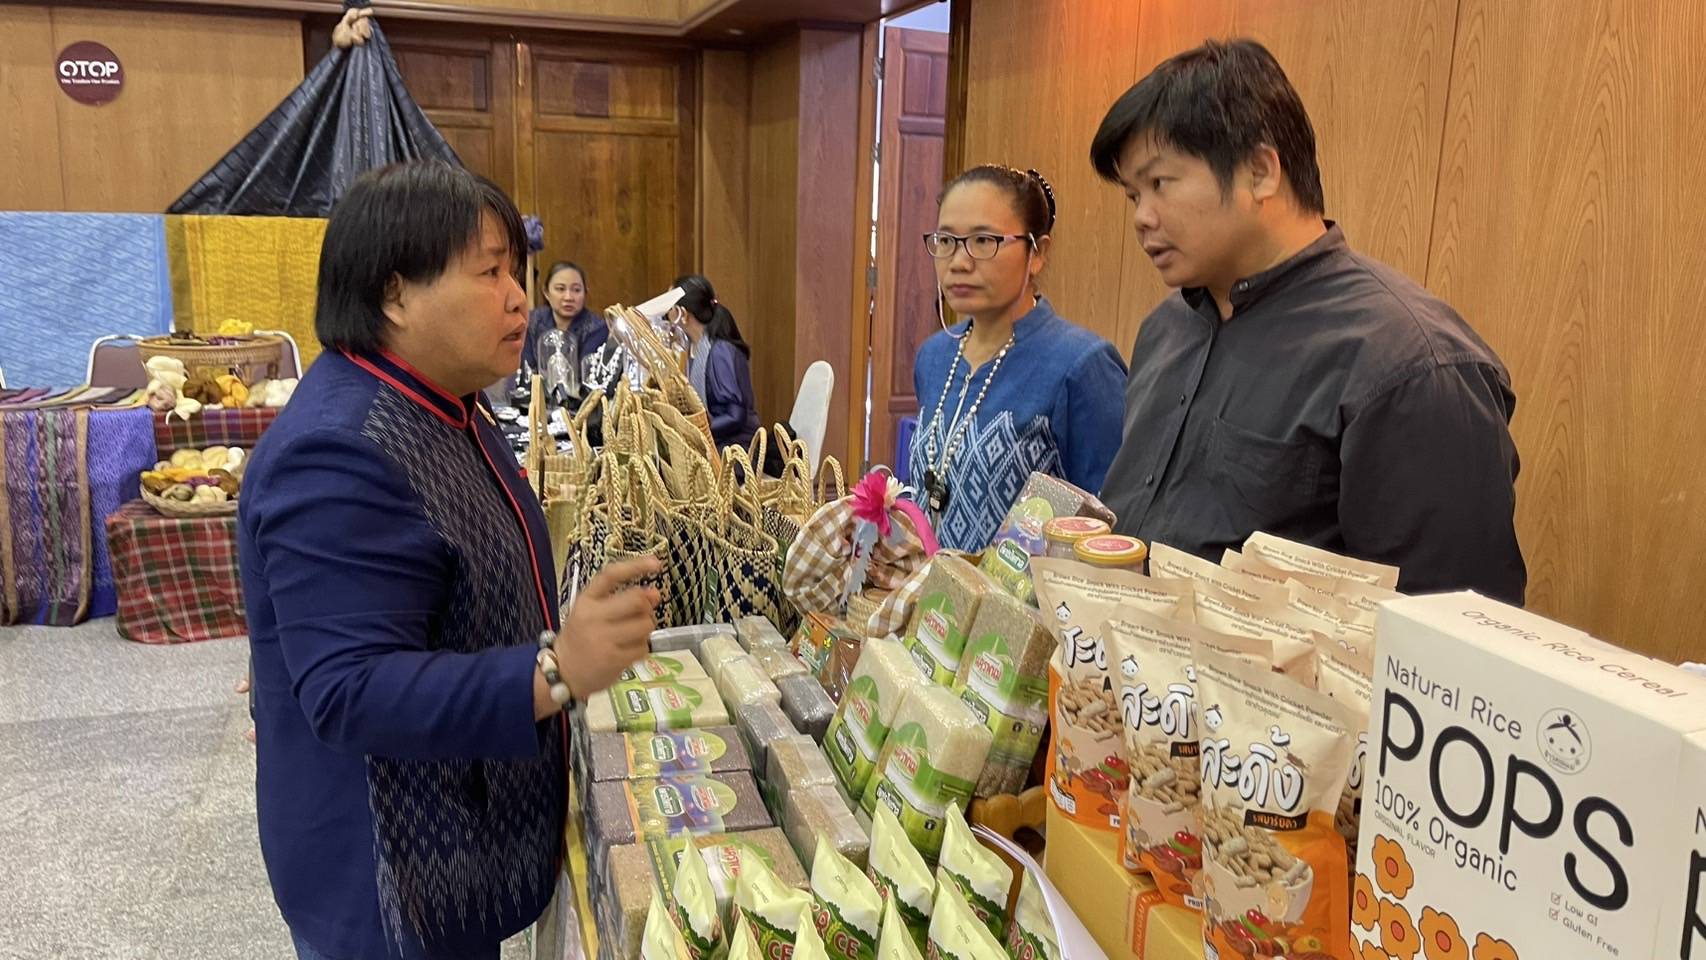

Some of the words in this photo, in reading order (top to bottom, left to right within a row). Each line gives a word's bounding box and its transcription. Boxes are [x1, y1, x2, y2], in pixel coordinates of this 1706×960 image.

[59, 60, 119, 78] OTOP
[1461, 610, 1542, 643] Organic
[1542, 641, 1595, 663] Rice
[1600, 662, 1689, 699] Cereal
[1280, 695, 1305, 709] Cricket
[1306, 705, 1333, 722] Powder
[1385, 654, 1461, 712] Natural
[1470, 695, 1523, 741] Rice
[1201, 724, 1305, 813] สะดิ้ง
[1374, 810, 1404, 840] ORIGINAL
[1406, 833, 1437, 860] FLAVOR
[1375, 779, 1421, 831] 100%
[1429, 816, 1518, 892] Organic
[1562, 916, 1593, 942] Gluten
[1596, 935, 1619, 957] Free
[1564, 900, 1584, 918] Low
[1586, 913, 1599, 927] GI
